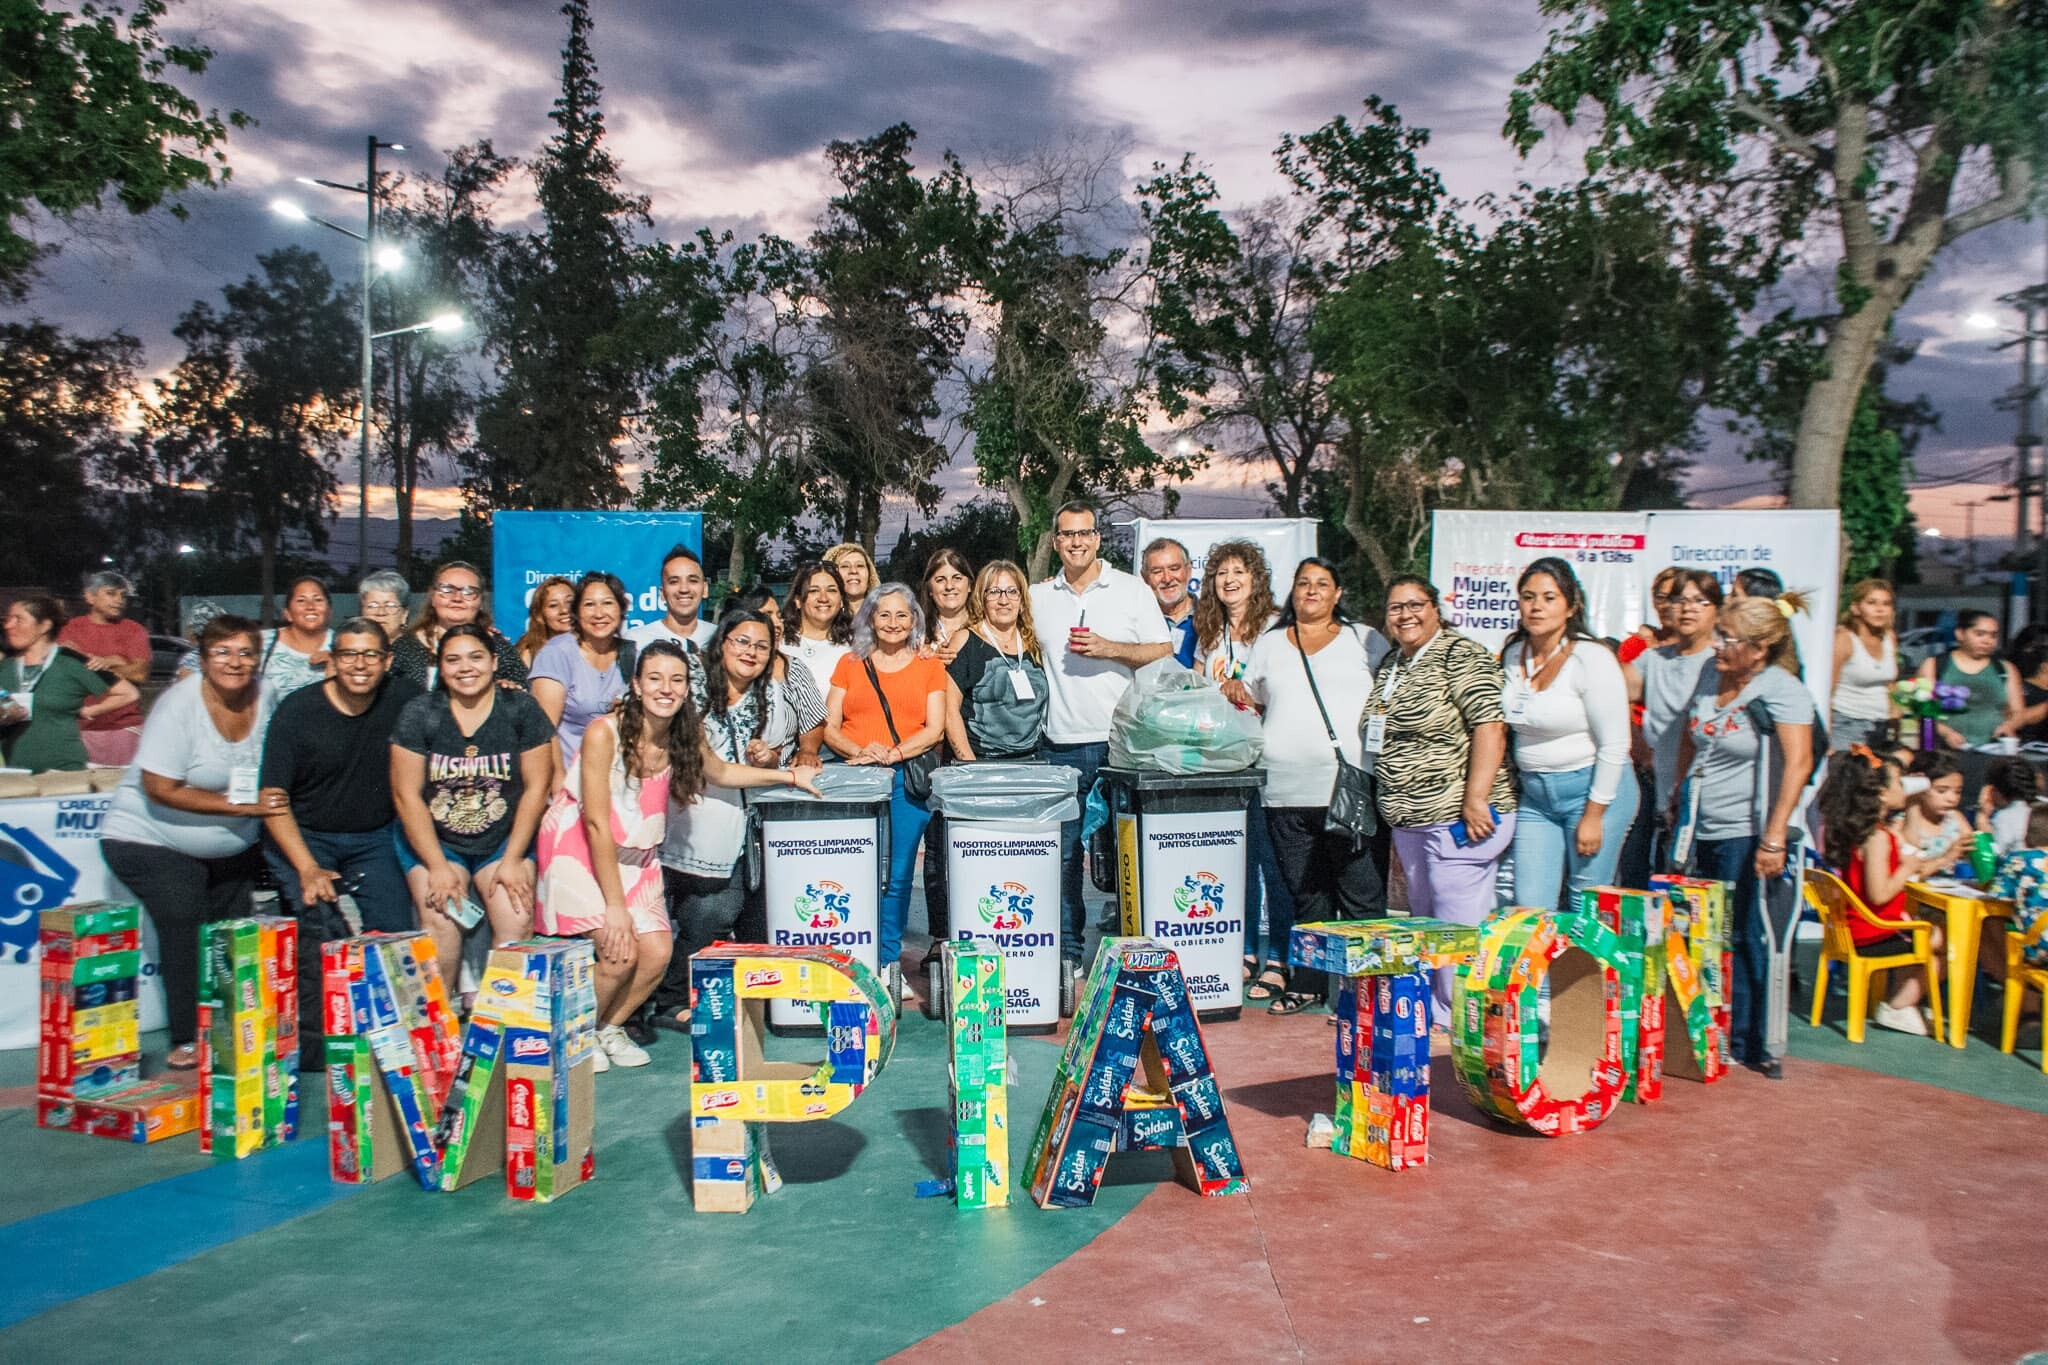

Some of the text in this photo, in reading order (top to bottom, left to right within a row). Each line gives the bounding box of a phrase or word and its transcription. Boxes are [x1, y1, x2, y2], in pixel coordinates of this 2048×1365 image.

[1672, 544, 1773, 561] Dirección de
[1453, 576, 1512, 597] Mujer,
[1453, 594, 1520, 610] Género
[1452, 612, 1523, 630] Diversi
[430, 752, 511, 782] NASHVILLE
[58, 800, 111, 811] CARLO
[768, 838, 874, 848] NOSOTROS LIMPIAMOS,
[1149, 829, 1244, 841] NOSOTROS LIMPIAMOS,
[777, 846, 865, 858] JUNTOS CUIDAMOS.
[953, 840, 1058, 849] NOSOTROS LIMPIAMOS,
[962, 848, 1049, 859] JUNTOS CUIDAMOS.
[1158, 838, 1237, 851] JUNTOS CUIDAMOS.
[1123, 853, 1134, 936] LASTICO
[775, 929, 872, 946] Rawson
[1154, 919, 1241, 938] Rawson
[1174, 937, 1224, 947] GOBIERNO
[1006, 950, 1034, 958] ERNO
[745, 969, 782, 988] talca
[1185, 974, 1220, 985] ARLOS
[1149, 971, 1178, 1011] Saldan
[1188, 983, 1230, 995] NISAGA
[702, 977, 723, 1020] Saldan
[1006, 998, 1041, 1008] SAGA
[1116, 997, 1135, 1040] Saldan
[1170, 1037, 1198, 1076] Saldan
[703, 1049, 725, 1083] Salda
[1094, 1066, 1113, 1109] Saldan
[701, 1092, 739, 1110] talca
[1185, 1078, 1213, 1120] Saldan
[1133, 1119, 1174, 1142] Saldan
[1203, 1142, 1231, 1179] Saldan
[1067, 1149, 1085, 1192] Saldan
